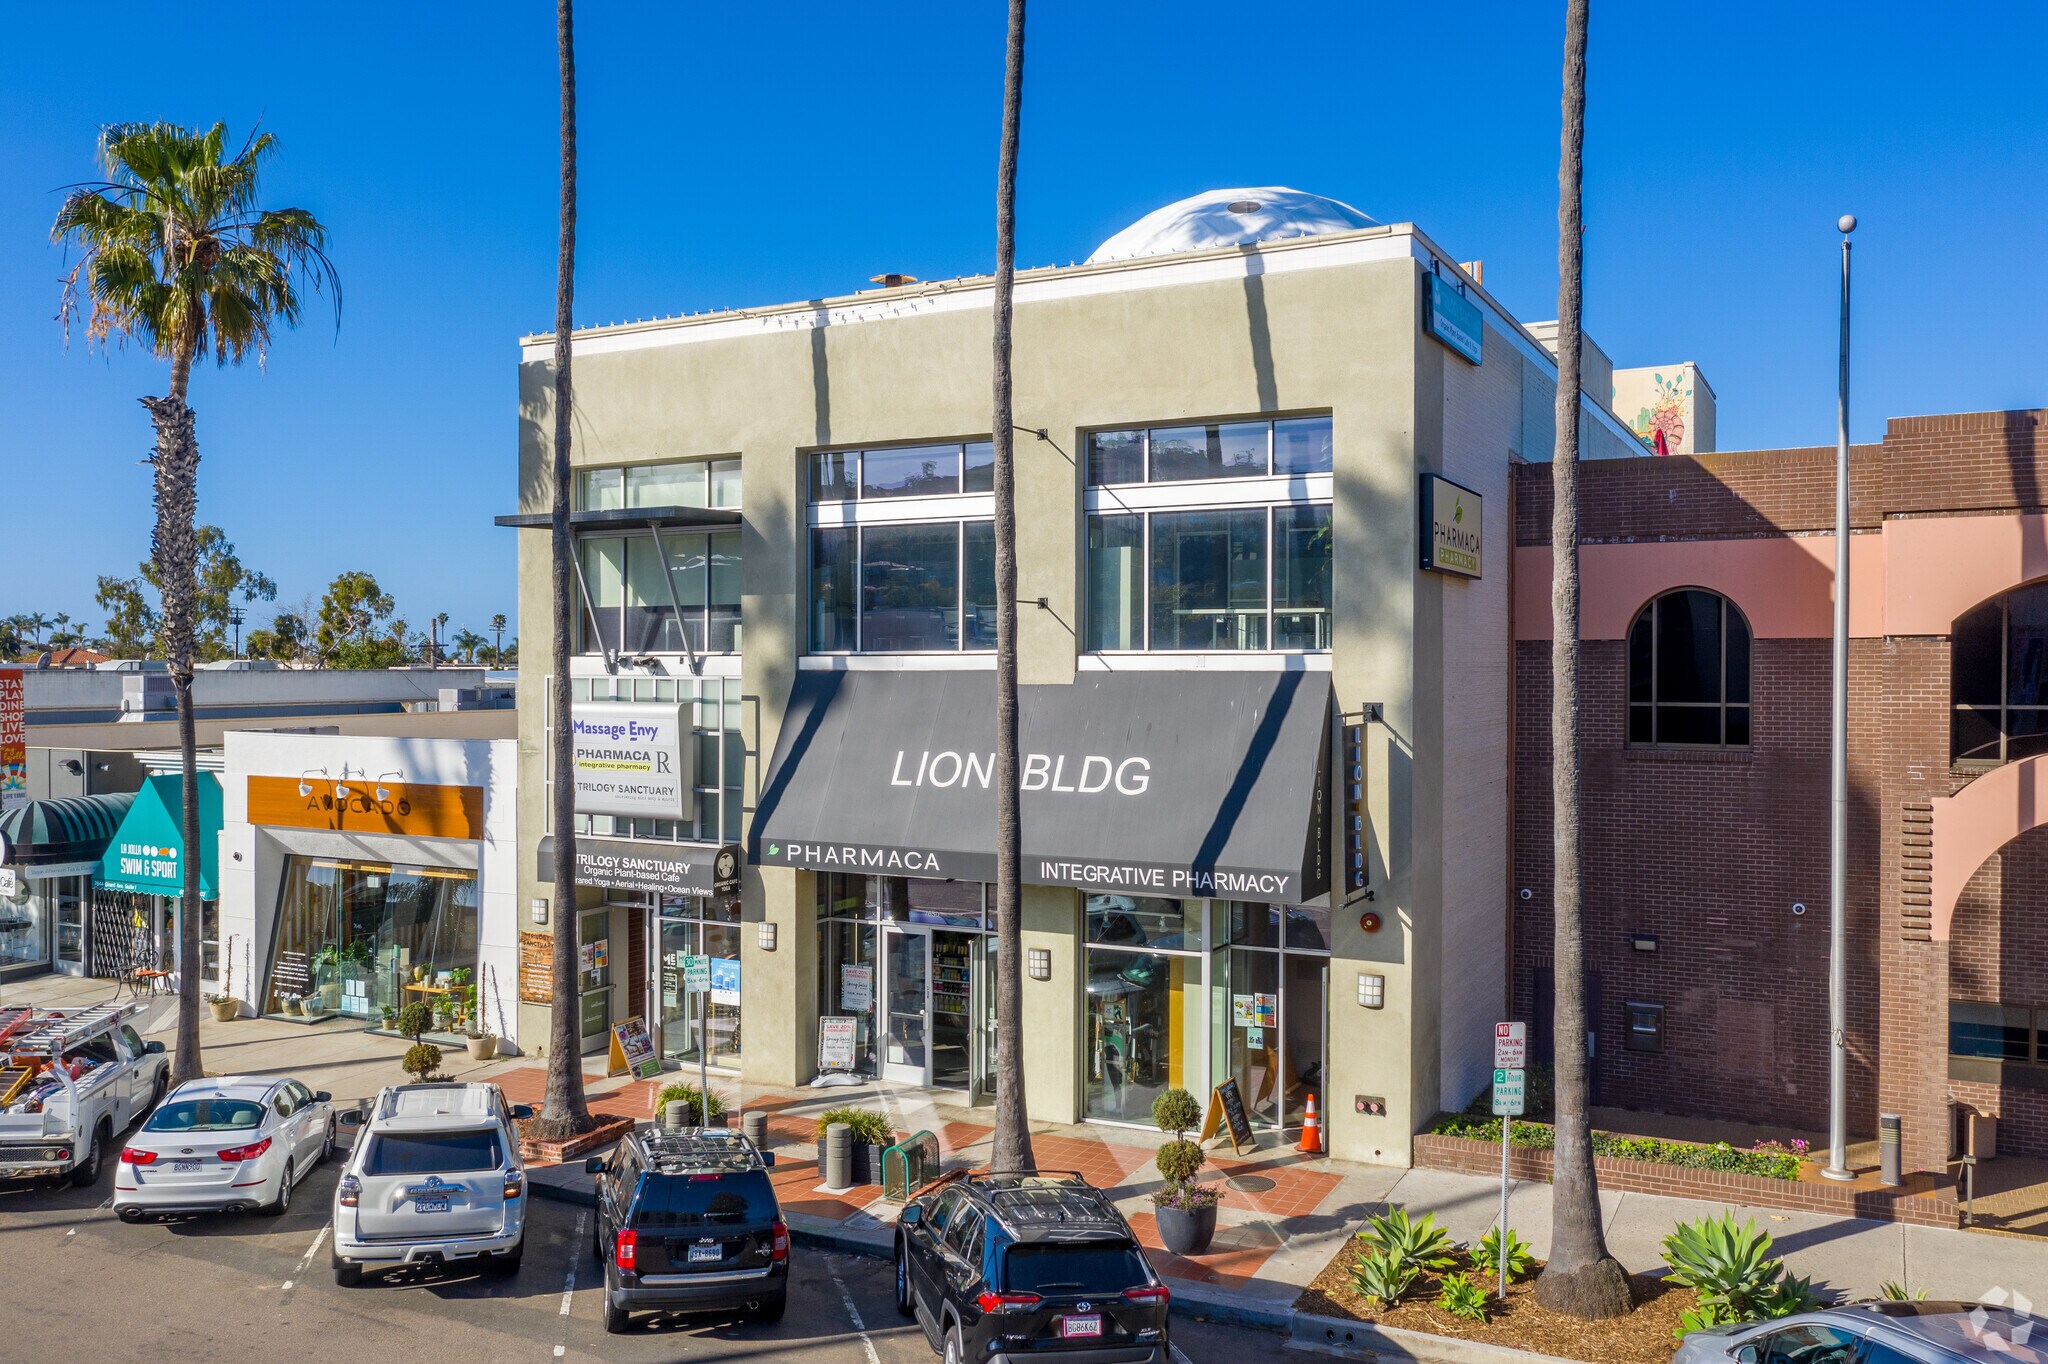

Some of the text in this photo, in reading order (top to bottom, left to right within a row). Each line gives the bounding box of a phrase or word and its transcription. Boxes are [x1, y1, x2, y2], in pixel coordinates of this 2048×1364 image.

[1435, 521, 1480, 555] PHARMACA
[1441, 548, 1476, 570] PHARMACY
[0, 722, 25, 733] LIVE
[573, 720, 658, 741] Massage Envy
[0, 733, 25, 744] LOVE
[577, 749, 651, 761] PHARMACA
[578, 761, 651, 771] integrative pharmacy
[1353, 727, 1363, 800] LION
[891, 750, 1151, 795] LION BLDG
[577, 782, 674, 796] TRILOGY SANCTUARY
[307, 796, 411, 816] AVOCADO
[121, 843, 141, 855] LA JOLLA
[1354, 815, 1364, 887] BLDG
[121, 857, 177, 878] SWIM & SPORT
[576, 853, 690, 874] TRILOGY SANCTUARY
[787, 844, 1289, 894] PHARMACA INTEGRATIVE PHARMACY
[584, 866, 680, 883] Organic Plant-based Cafe
[594, 878, 611, 887] Yoga
[615, 880, 634, 889] Aerial
[638, 882, 664, 893] Healing
[667, 884, 690, 896] Ocean
[691, 886, 713, 896] Views
[522, 940, 554, 948] SANCTUARY
[685, 956, 694, 967] 30
[687, 967, 708, 976] PARKING
[1498, 1025, 1508, 1036] NO
[1499, 1038, 1523, 1047] PARKING
[1496, 1072, 1521, 1082] 2 HOUR
[1496, 1086, 1522, 1096] PARKING
